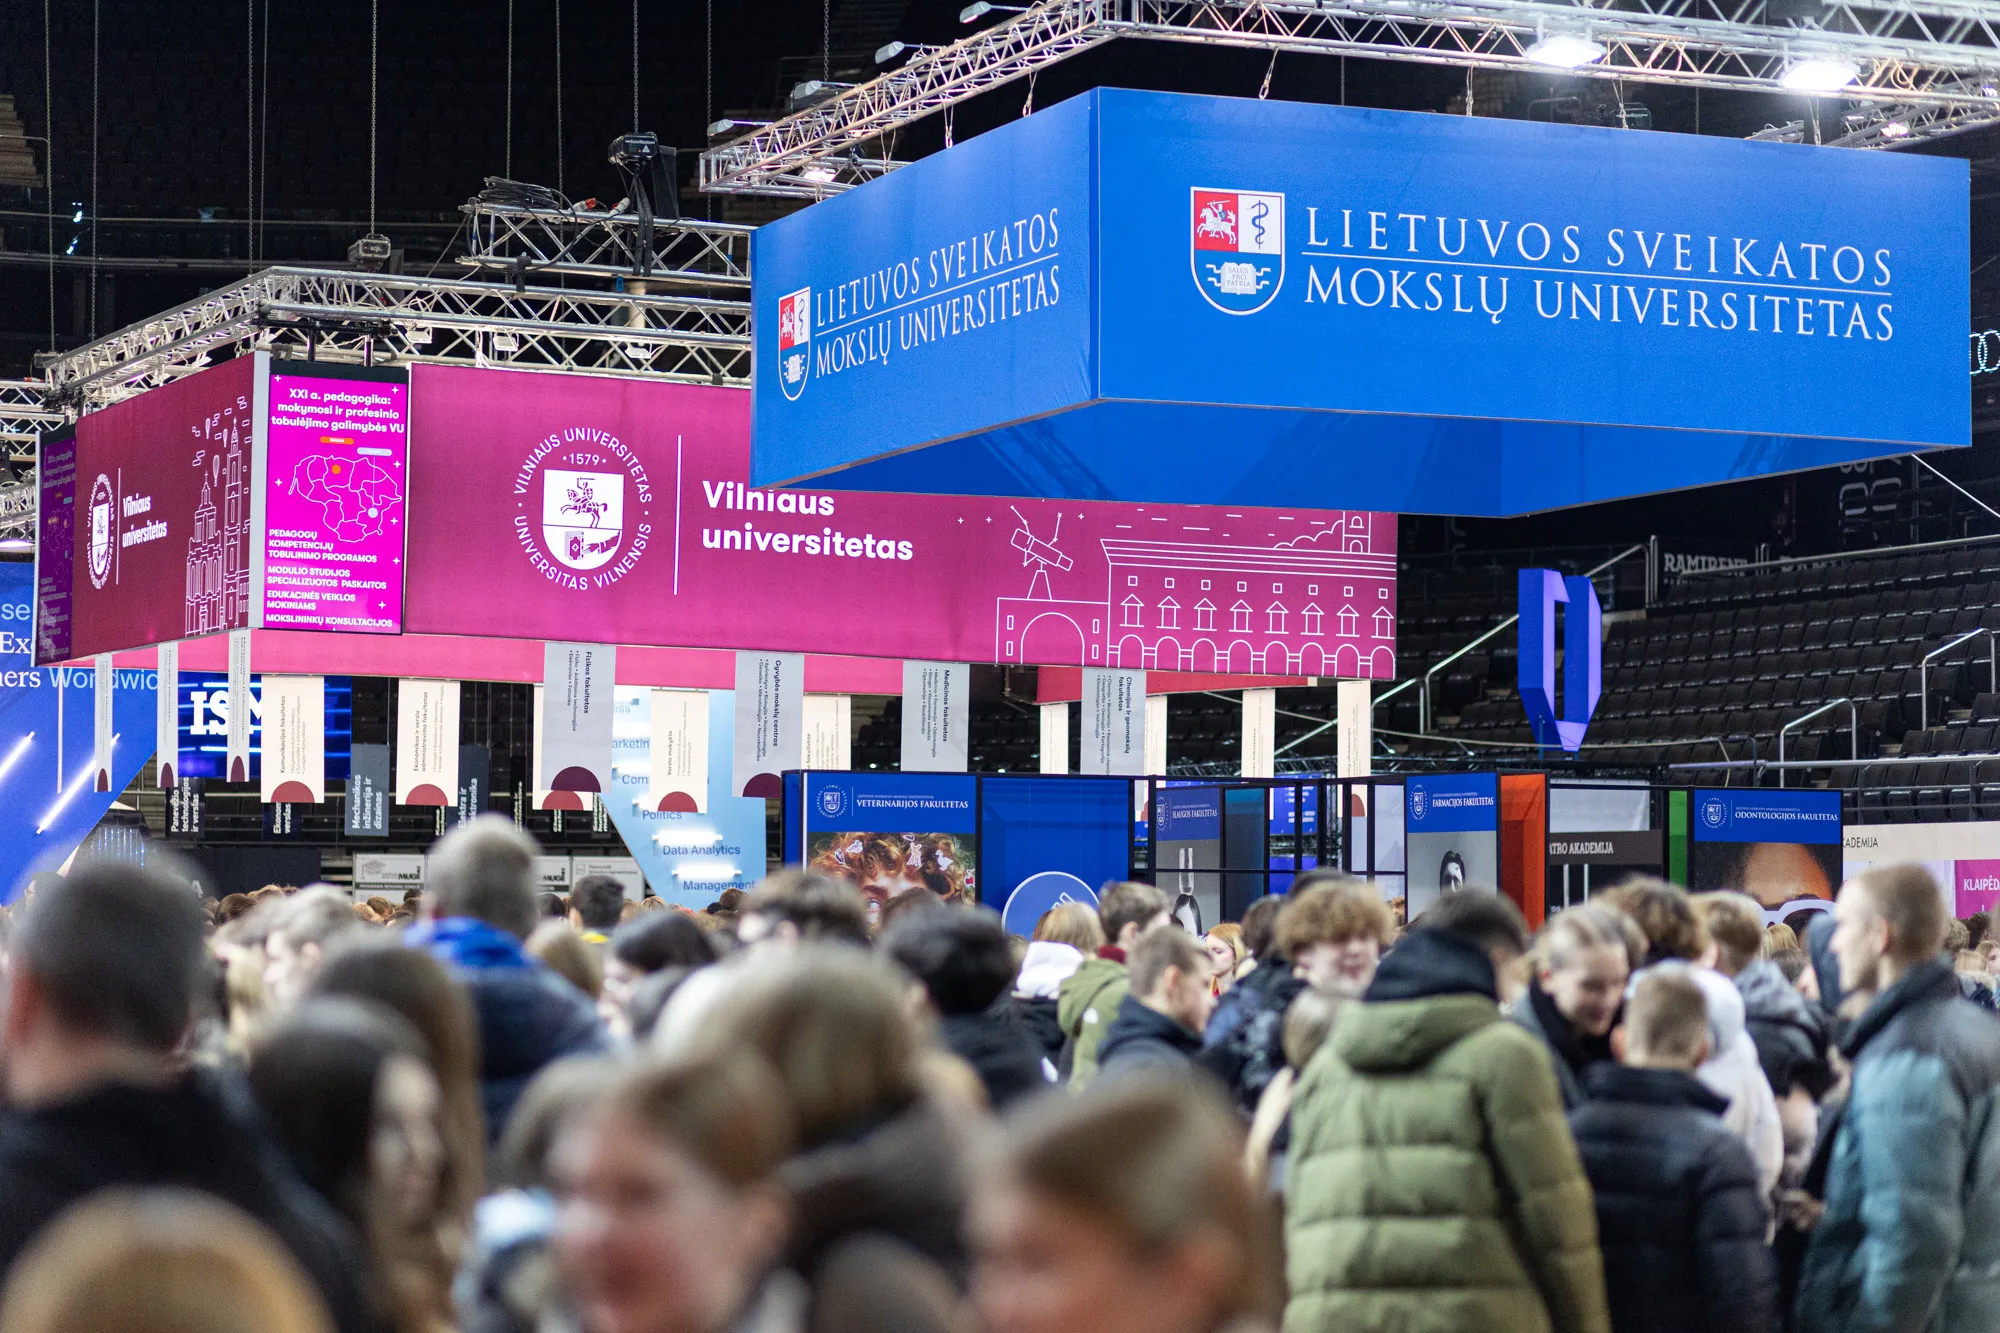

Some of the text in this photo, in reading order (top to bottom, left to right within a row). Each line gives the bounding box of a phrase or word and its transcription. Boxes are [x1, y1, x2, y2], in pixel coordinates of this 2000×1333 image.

[1306, 206, 1891, 287] LIETUVOS SVEIKATOS
[817, 207, 1058, 328] LIETUVOS SVEIKATOS
[1228, 266, 1249, 274] SALUS
[1304, 263, 1894, 342] MOKSLŲ UNIVERSITETAS
[816, 265, 1060, 379] MOKSLŲ UNIVERSITETAS
[289, 388, 308, 399] XXI
[323, 392, 391, 405] pedagogika:
[277, 403, 400, 420] mokymosi ir profesinio
[271, 415, 404, 433] tobulėjimo galimybės VU
[514, 427, 652, 503] VILNIAUS UNIVERSITETAS
[569, 453, 600, 466] 1579
[122, 493, 151, 518] Vilniaus
[702, 480, 835, 516] Vilniaus
[122, 519, 167, 548] universitetas
[268, 529, 318, 541] PEDAGOGŲ
[702, 522, 914, 561] universitetas
[268, 539, 334, 552] KOMPETENCIJŲ
[514, 515, 651, 590] UNIVERSITAS VILNENSIS
[268, 550, 377, 563] TOBULINIMO PROGRAMOS
[267, 566, 350, 577] MODULIO STUDIJOS
[267, 576, 387, 590] SPECIALIZUOTOS PASKAITOS
[267, 590, 356, 602] EDUKACINĖS VEIKLOS
[266, 601, 316, 611] MOKINIAMS
[265, 613, 393, 627] MOKSLININKŲ KONSULTACIJOS
[0, 632, 33, 654] Ex
[774, 659, 782, 692] Gyvybės
[279, 728, 287, 774] Komunikacijos
[412, 735, 420, 772] Ekonomikos
[180, 777, 191, 833] technologijos
[352, 774, 361, 829] Mechanikos
[362, 777, 374, 829] inžinerija ir
[457, 786, 467, 829] Elektra ir
[468, 777, 478, 824] lektronika
[856, 799, 969, 809] VETERINARIJOS FAKULTETAS
[1432, 796, 1494, 808] FARMACIJOS FAKULTETAS
[190, 793, 199, 833] ir verslas
[374, 791, 383, 830] dizainas
[642, 809, 682, 820] Politics
[1172, 808, 1218, 819] SLAUGOS FAKULTETAS
[1734, 811, 1839, 821] ODONTOLOGIJOS FAKULTETAS
[663, 844, 741, 858] Data Analytics
[1568, 841, 1614, 854] AKADEMIJA
[683, 880, 756, 893] Management
[1964, 874, 2000, 891] KLAIPĖD
